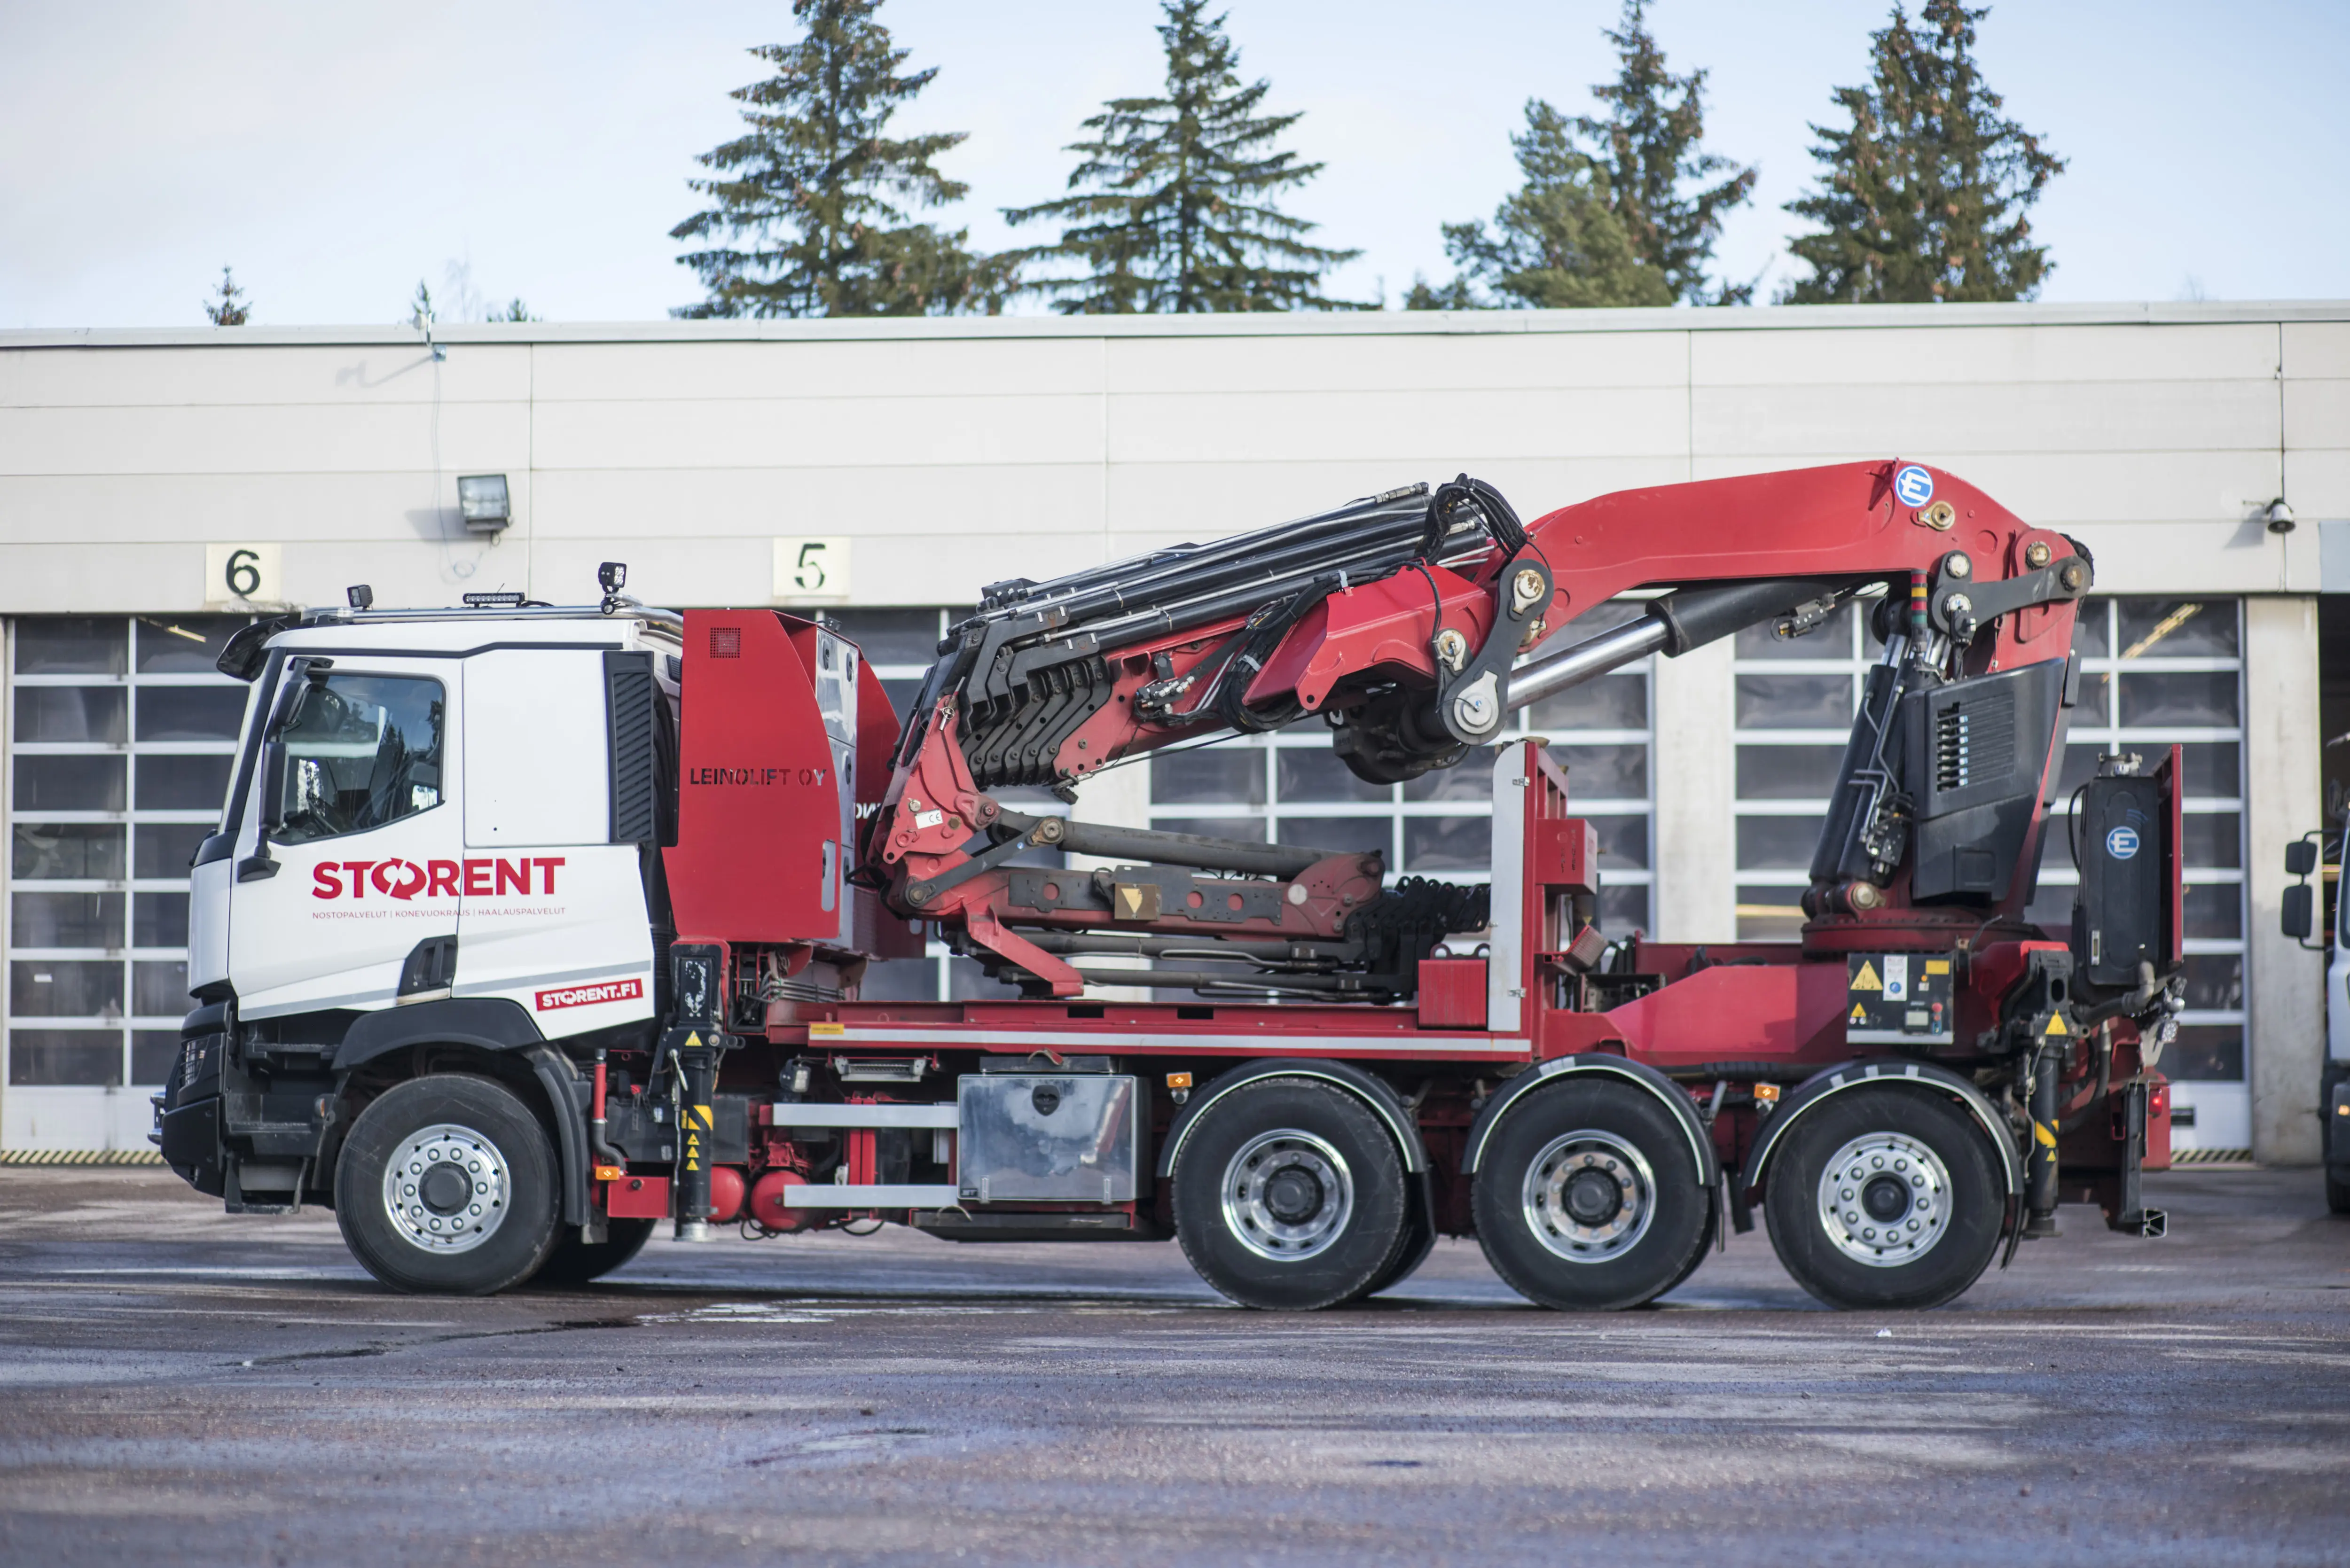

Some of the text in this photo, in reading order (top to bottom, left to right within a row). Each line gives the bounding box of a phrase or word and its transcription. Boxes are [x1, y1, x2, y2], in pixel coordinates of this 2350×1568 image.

[226, 549, 260, 596] 6
[794, 542, 826, 590] 5
[690, 768, 826, 786] LEINOLIFT OY
[929, 812, 941, 823] CE
[312, 857, 565, 901] STORENT
[312, 907, 566, 919] NOSTOPALVELUT KONEVUOKRAUS HAALAUSPALVELUT
[542, 982, 637, 1007] STORENT.FI
